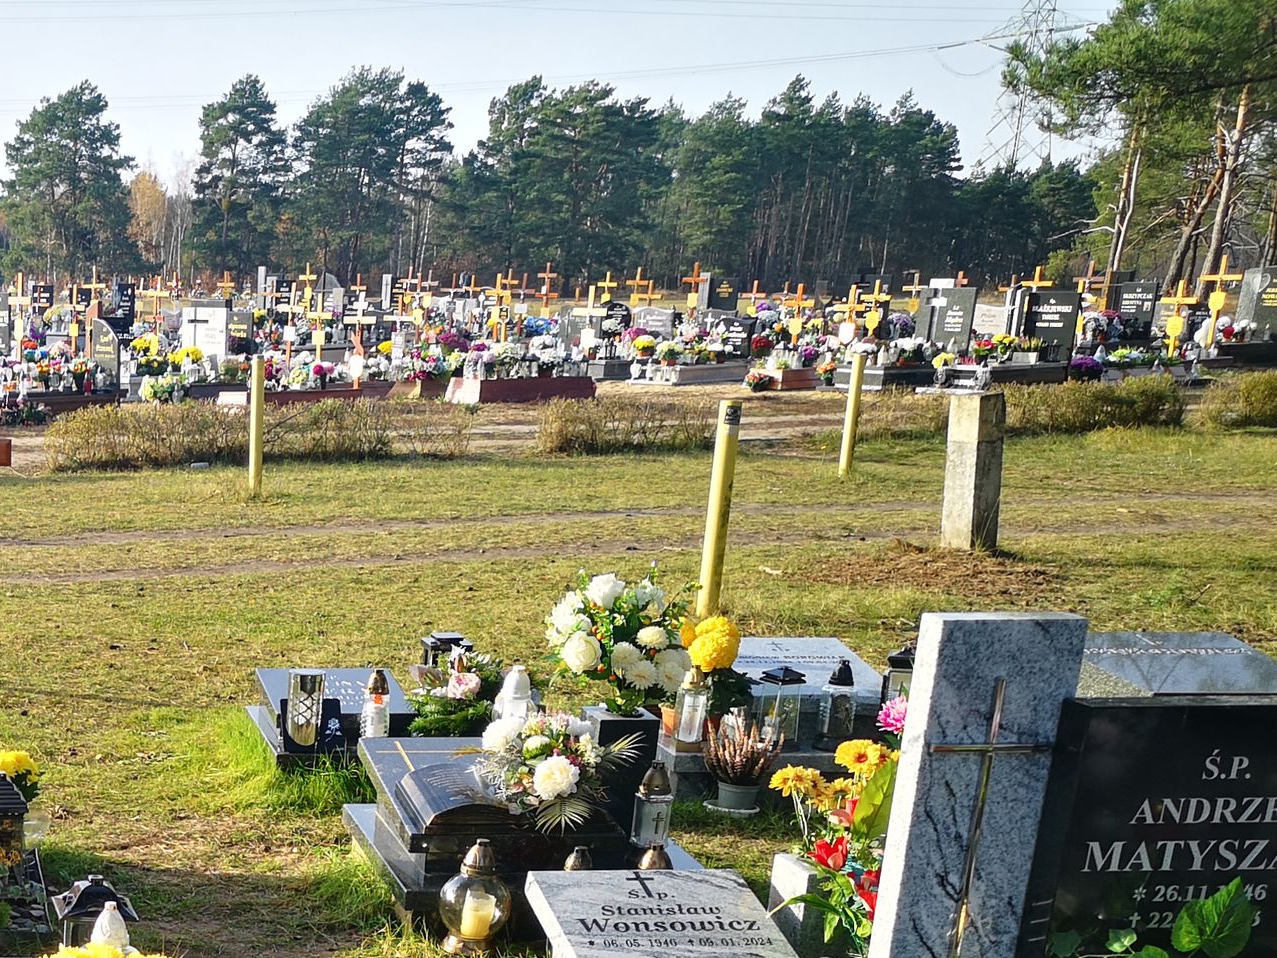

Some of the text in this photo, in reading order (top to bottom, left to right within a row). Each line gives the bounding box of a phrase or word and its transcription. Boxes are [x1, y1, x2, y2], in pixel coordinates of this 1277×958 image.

[1202, 749, 1252, 780] Ś.P.
[601, 903, 722, 916] Stanisław
[576, 916, 761, 933] Wonsowicz
